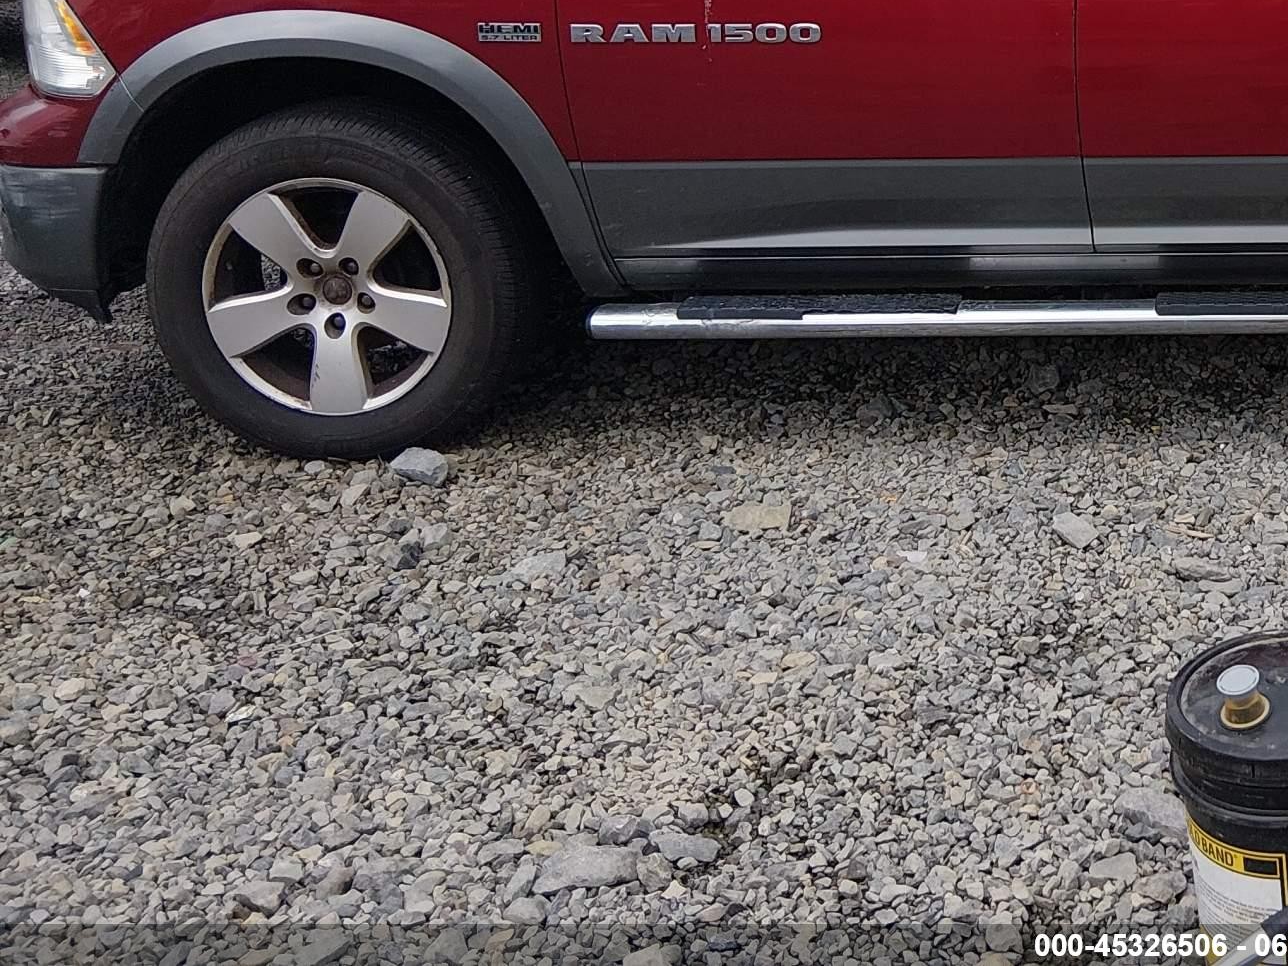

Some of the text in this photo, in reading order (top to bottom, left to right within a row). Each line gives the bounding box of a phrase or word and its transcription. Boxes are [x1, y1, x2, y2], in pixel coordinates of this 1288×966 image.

[478, 23, 540, 34] HEMI
[569, 22, 822, 43] RAM 1500
[1201, 836, 1235, 867] BAND
